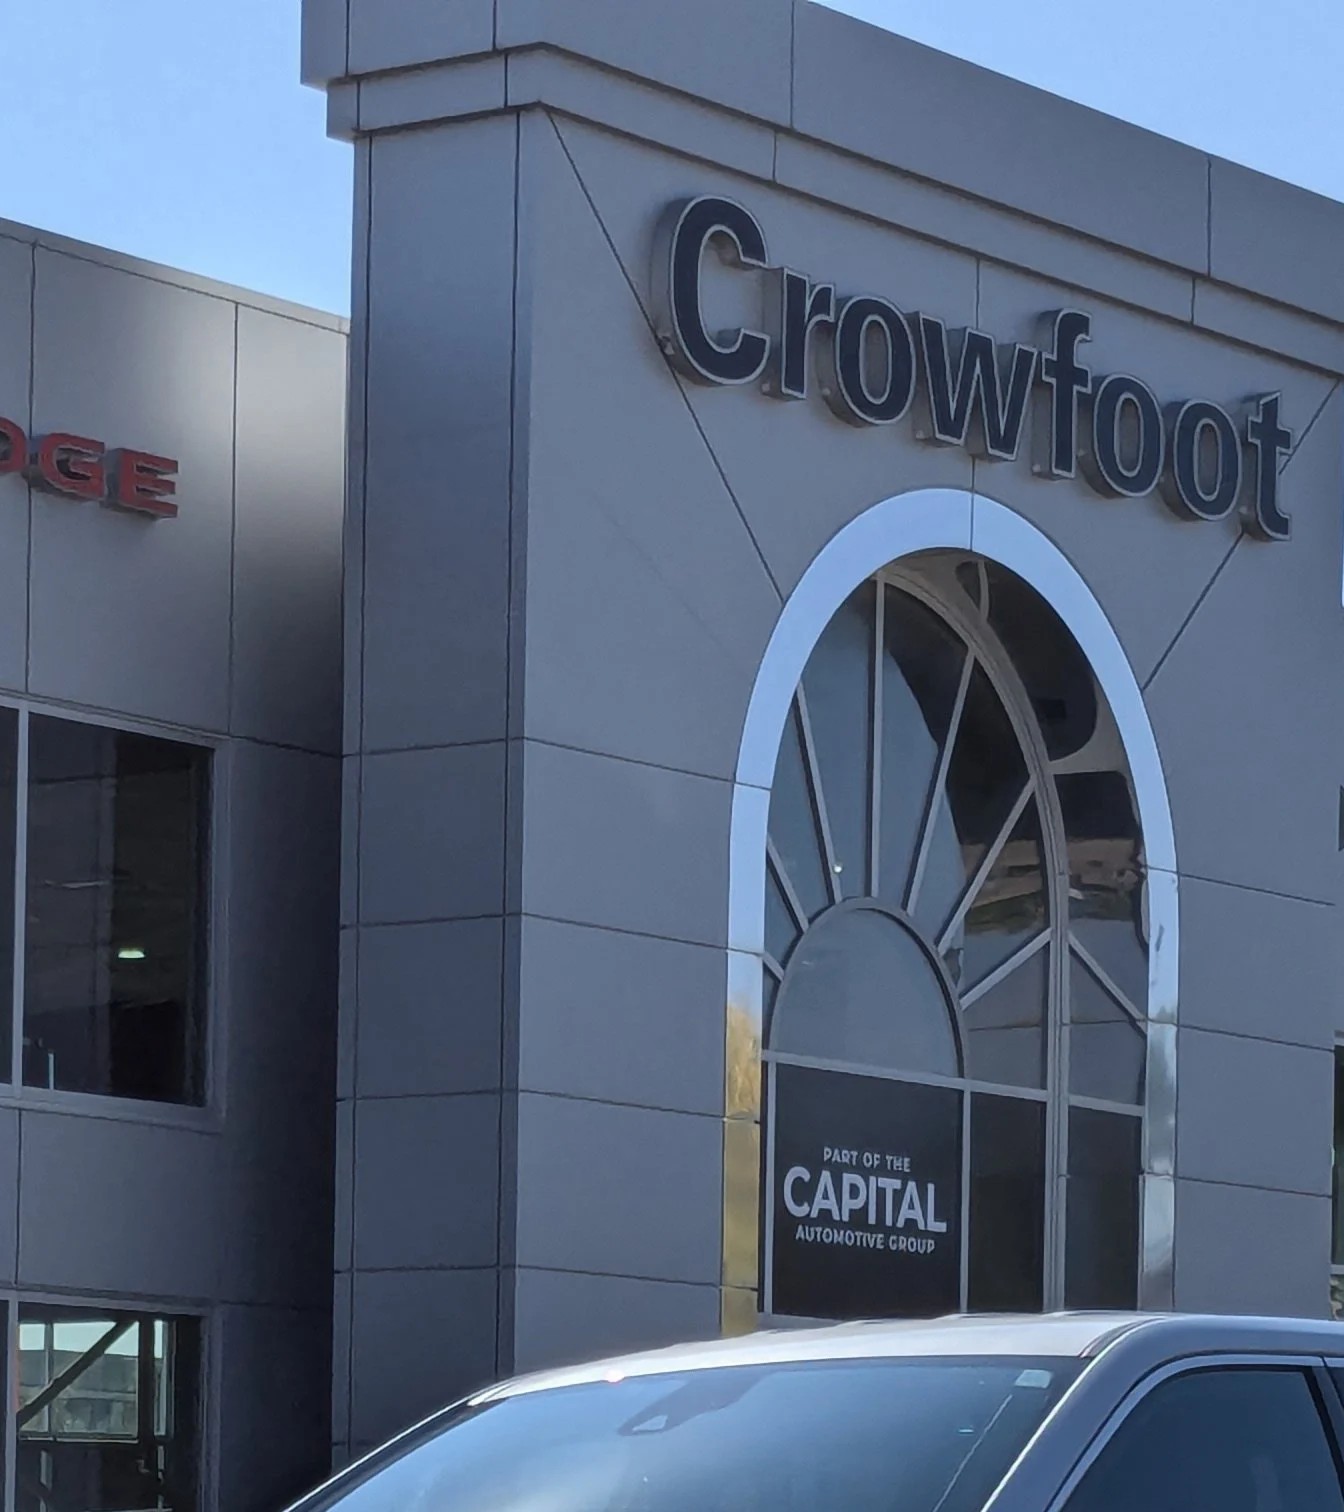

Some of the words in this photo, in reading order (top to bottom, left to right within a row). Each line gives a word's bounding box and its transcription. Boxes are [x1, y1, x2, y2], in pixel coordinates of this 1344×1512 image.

[666, 195, 1292, 540] Crowfoot
[823, 1146, 859, 1166] PART
[862, 1151, 881, 1169] OF
[886, 1155, 912, 1173] THE
[783, 1166, 947, 1233] CAPITAL
[795, 1224, 885, 1250] AUTOMOTIVE
[889, 1234, 936, 1254] GROUP
